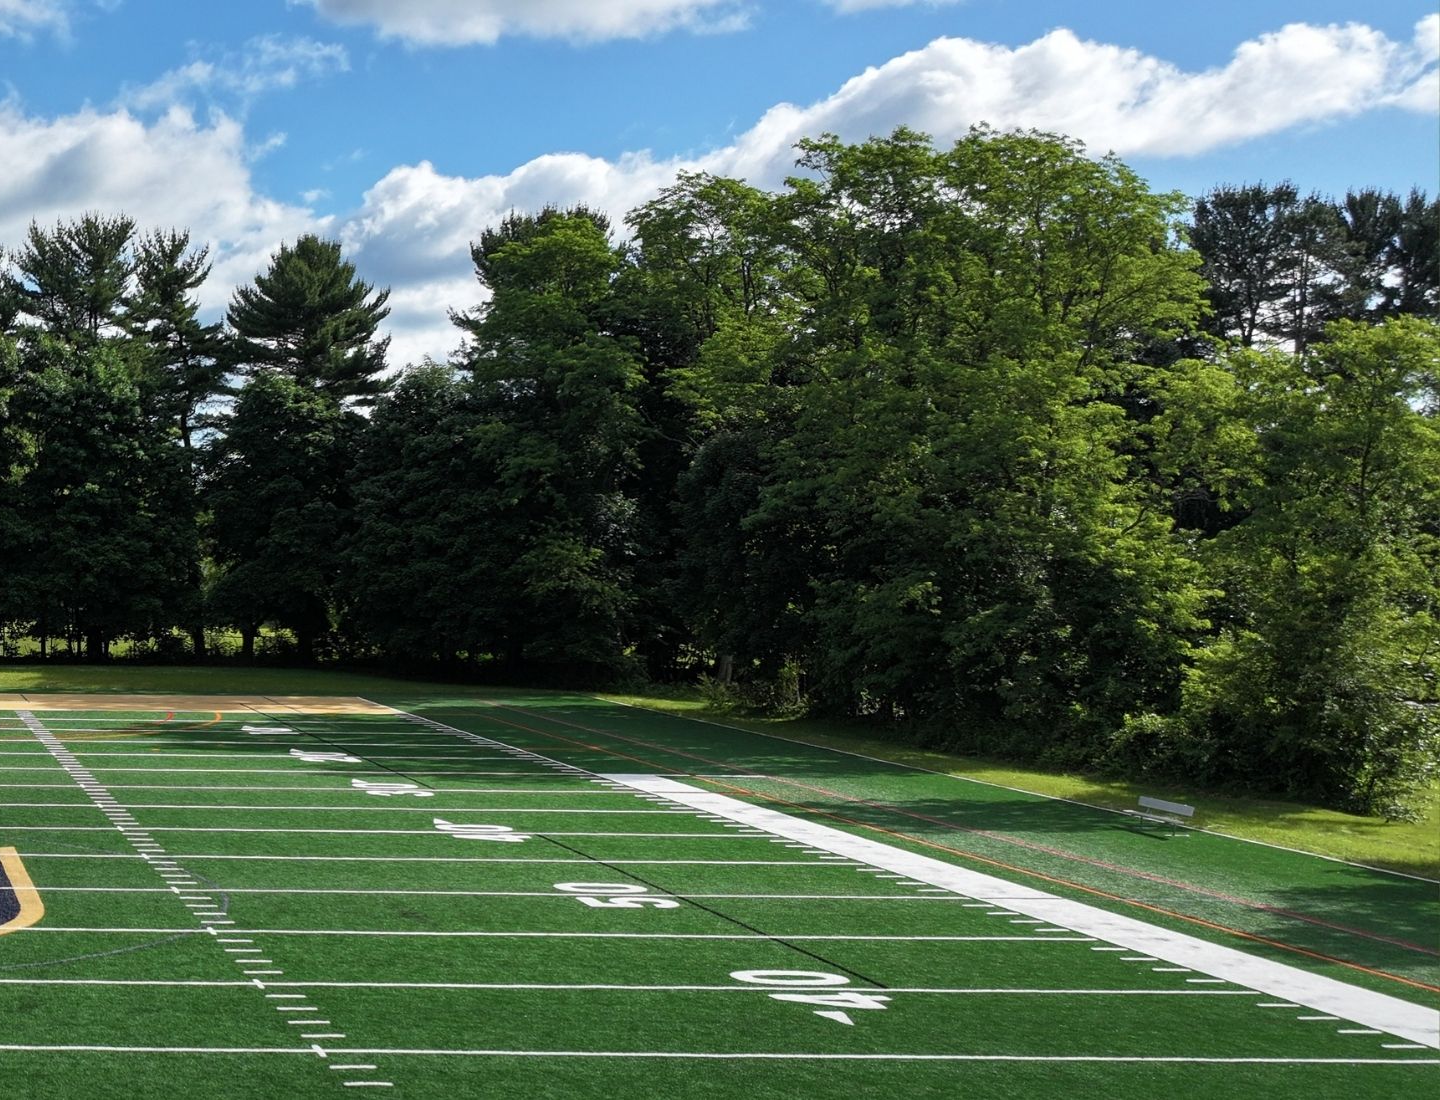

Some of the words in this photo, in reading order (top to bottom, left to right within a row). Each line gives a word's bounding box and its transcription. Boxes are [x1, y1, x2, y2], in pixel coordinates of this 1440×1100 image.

[352, 783, 434, 797] 30
[434, 824, 532, 842] 40
[553, 882, 680, 908] 50
[729, 970, 893, 1010] 40
